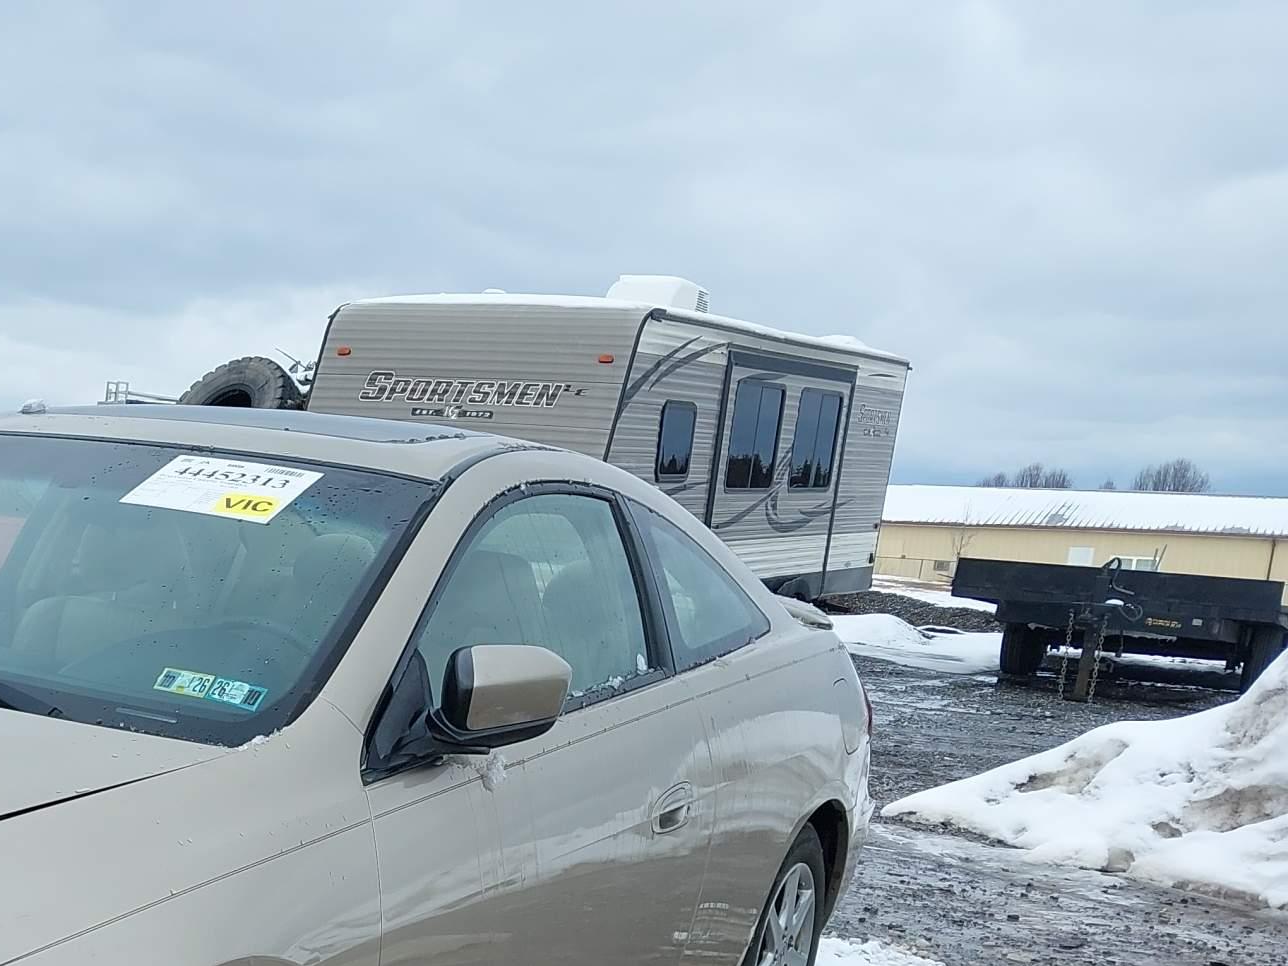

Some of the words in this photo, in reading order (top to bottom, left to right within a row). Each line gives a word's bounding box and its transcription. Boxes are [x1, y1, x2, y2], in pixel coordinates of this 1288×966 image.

[360, 371, 563, 407] SPORTSMEN
[174, 466, 290, 489] 44452313
[224, 497, 273, 512] VIC
[192, 677, 210, 693] 26
[211, 680, 230, 697] 26
